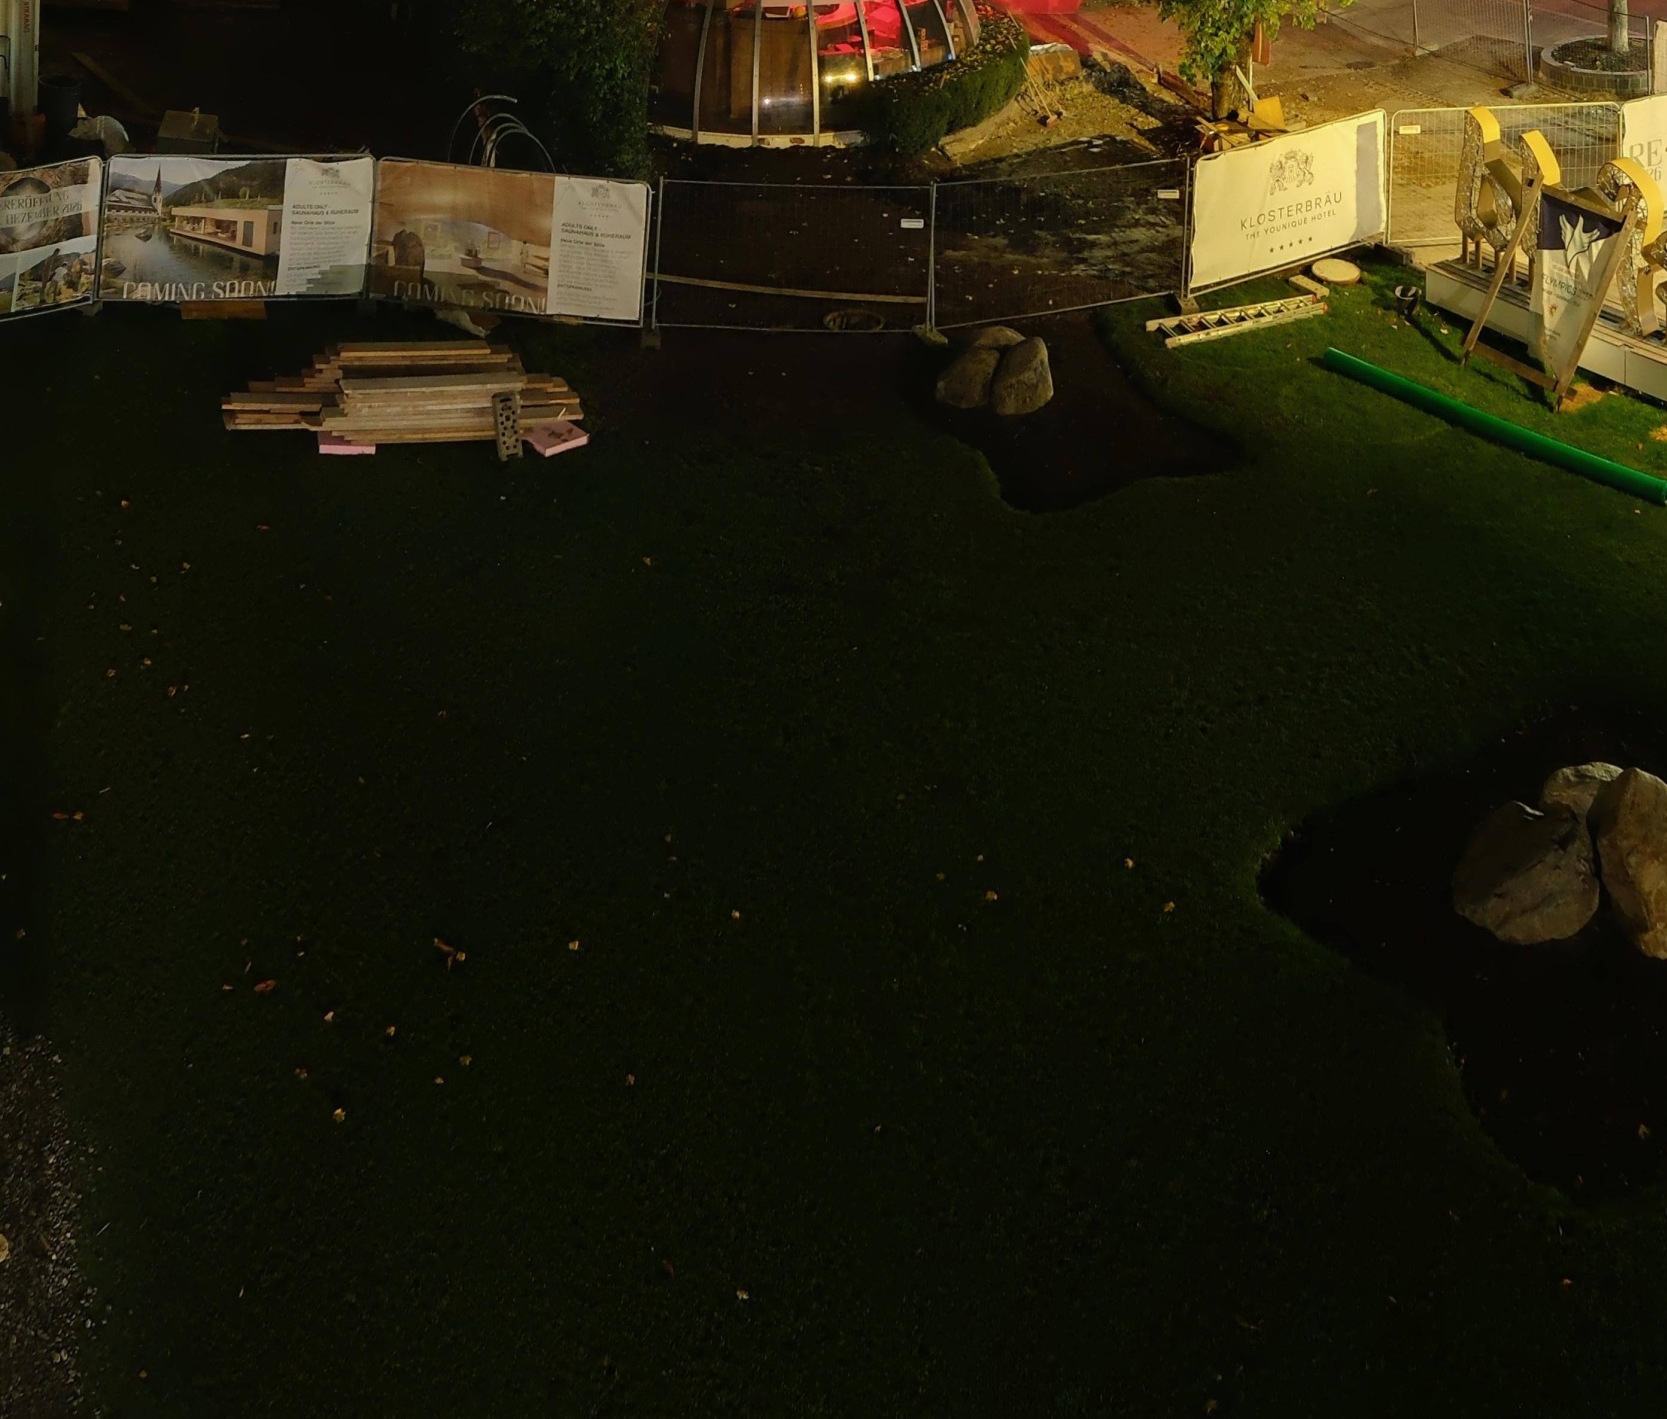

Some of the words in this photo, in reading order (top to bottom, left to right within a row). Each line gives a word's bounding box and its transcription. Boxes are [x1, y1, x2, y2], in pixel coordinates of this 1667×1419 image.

[1240, 191, 1343, 231] KLOSTERBRÄU
[1246, 231, 1260, 241] THE
[1264, 217, 1308, 234] YOUNIQUE
[1311, 209, 1336, 223] HOTEL
